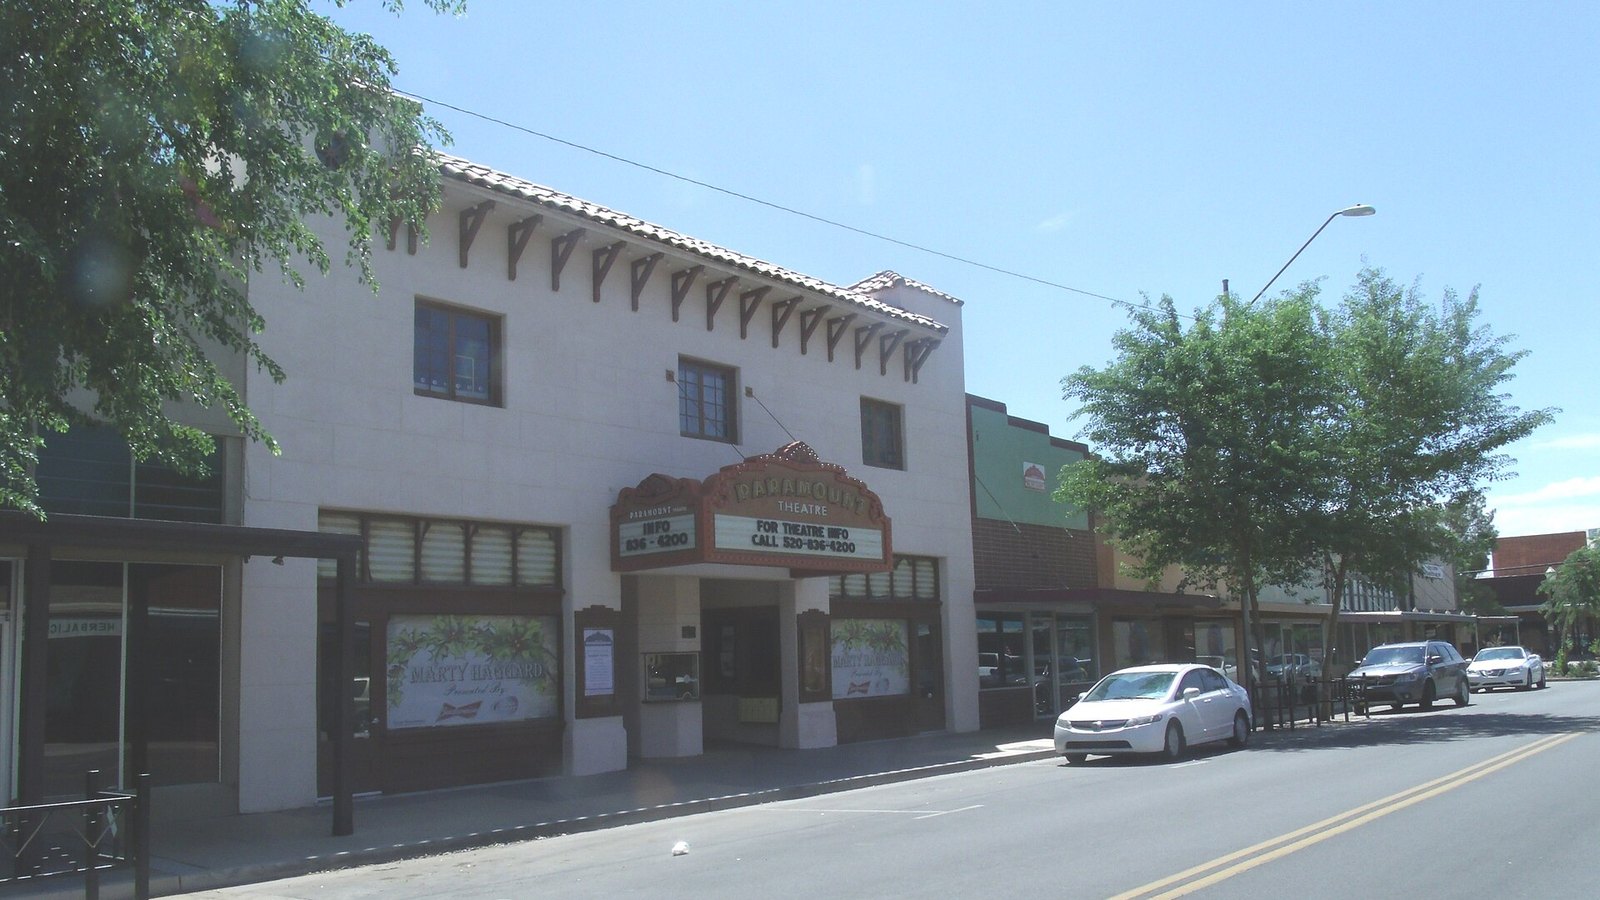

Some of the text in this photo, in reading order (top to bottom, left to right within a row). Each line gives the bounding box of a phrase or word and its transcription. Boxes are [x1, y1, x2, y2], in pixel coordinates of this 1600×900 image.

[735, 478, 868, 515] PARAMOUNT
[629, 506, 671, 519] PARAMOUNT
[778, 500, 828, 516] THEATRE
[643, 520, 670, 536] INFO
[757, 520, 849, 540] FOR THEATRE INFO
[751, 534, 855, 553] CALL 520-836-4200
[410, 662, 544, 683] MARTY HAGGARD
